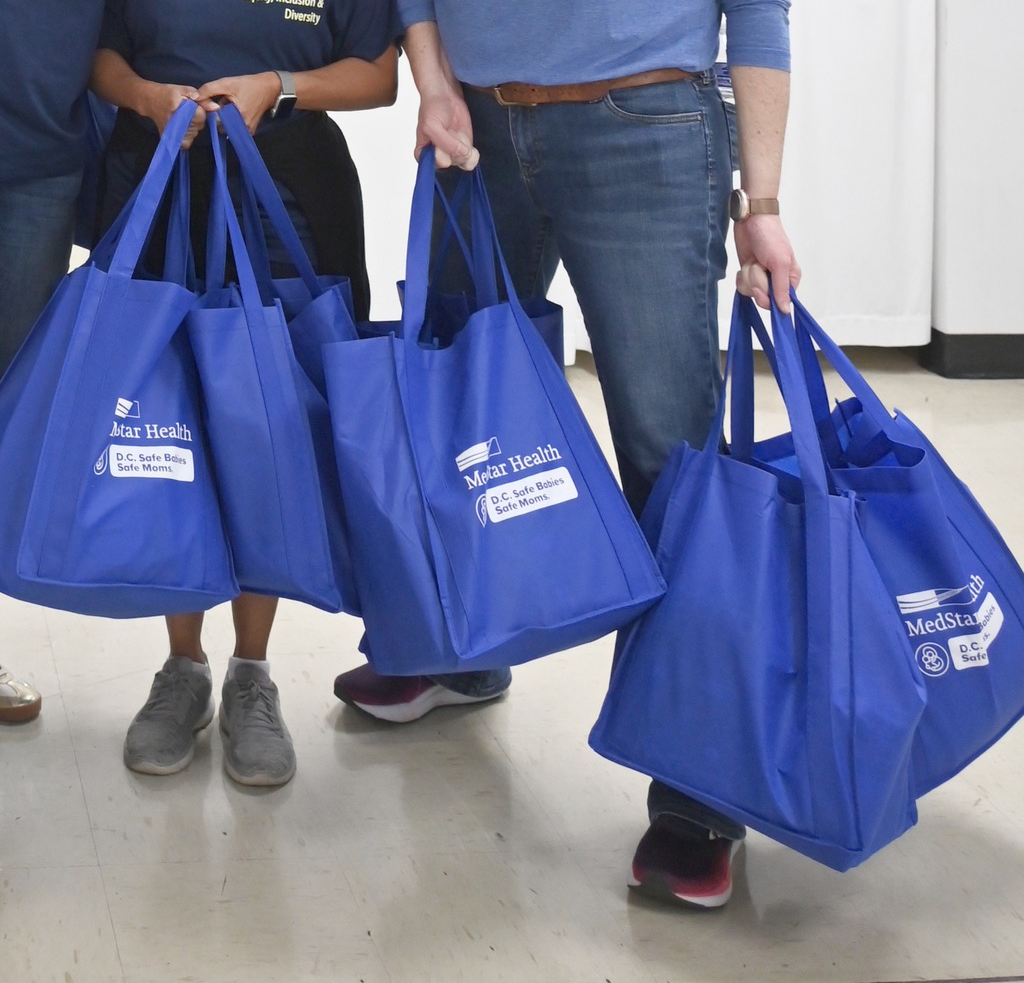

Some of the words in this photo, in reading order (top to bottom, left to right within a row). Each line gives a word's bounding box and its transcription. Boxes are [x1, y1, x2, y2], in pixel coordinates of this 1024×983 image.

[284, 8, 321, 25] Diversity
[145, 422, 192, 441] Health
[116, 453, 136, 461] D.C.
[139, 453, 161, 462] Safe
[508, 444, 562, 472] Health
[118, 463, 140, 472] Safe
[490, 492, 512, 504] D.C.
[513, 485, 534, 498] Safe
[535, 477, 565, 491] Babies
[495, 502, 518, 515] Safe
[519, 493, 550, 508] Moms.
[959, 642, 983, 653] D.C.
[962, 652, 987, 663] Safe
